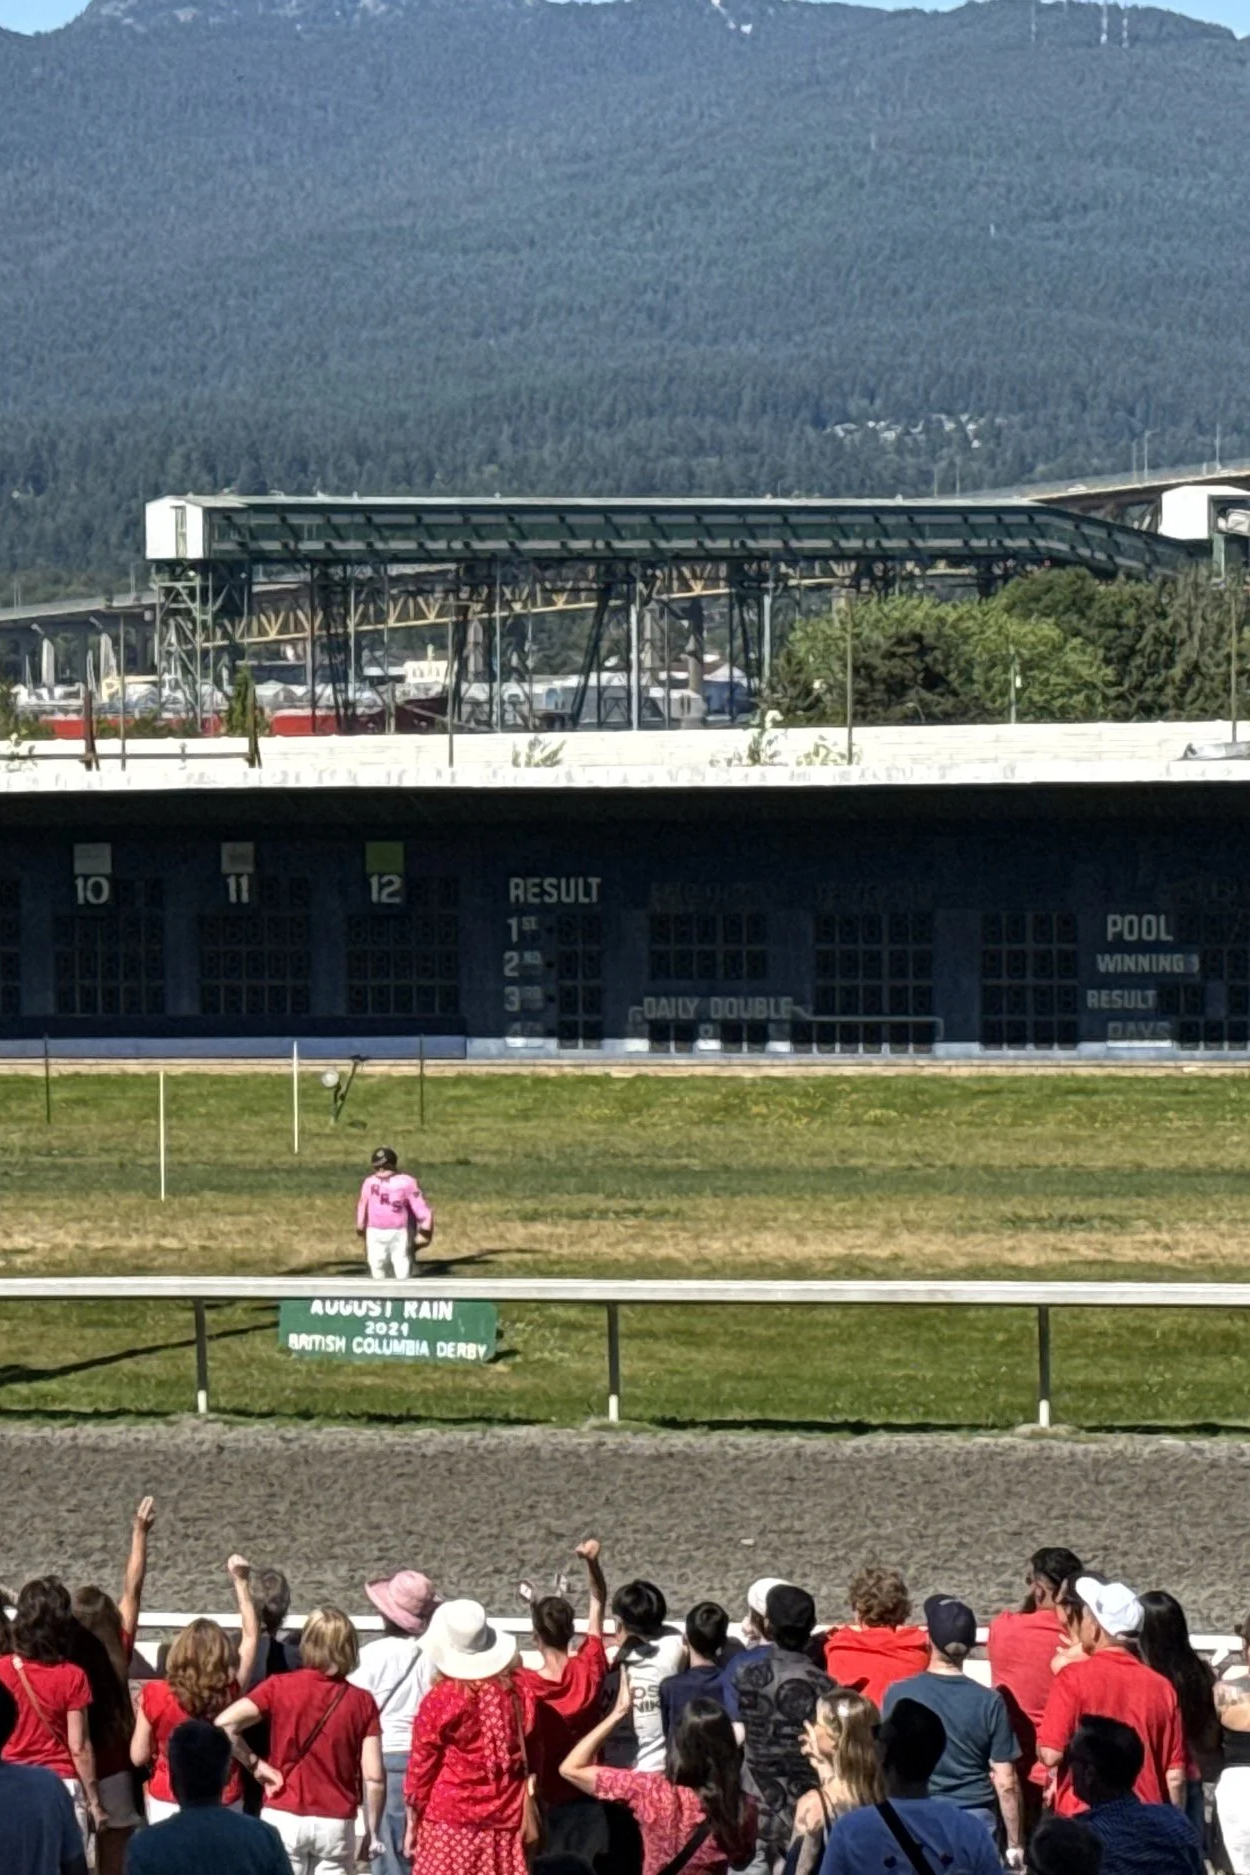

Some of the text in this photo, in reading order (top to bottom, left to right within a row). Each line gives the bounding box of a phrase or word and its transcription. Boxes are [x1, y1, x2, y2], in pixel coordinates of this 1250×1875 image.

[74, 876, 110, 905] 10
[226, 875, 249, 904] 11
[370, 874, 403, 904] 12
[509, 877, 601, 903] RESULT
[1106, 914, 1173, 942] POOL
[1097, 953, 1185, 973] WINNING
[643, 997, 793, 1019] DAILY DOUBLE
[1087, 990, 1157, 1010] RESULT
[310, 1299, 453, 1321] AUGUST RAIN
[288, 1333, 488, 1361] BRITISH COLUMBIA DERBY
